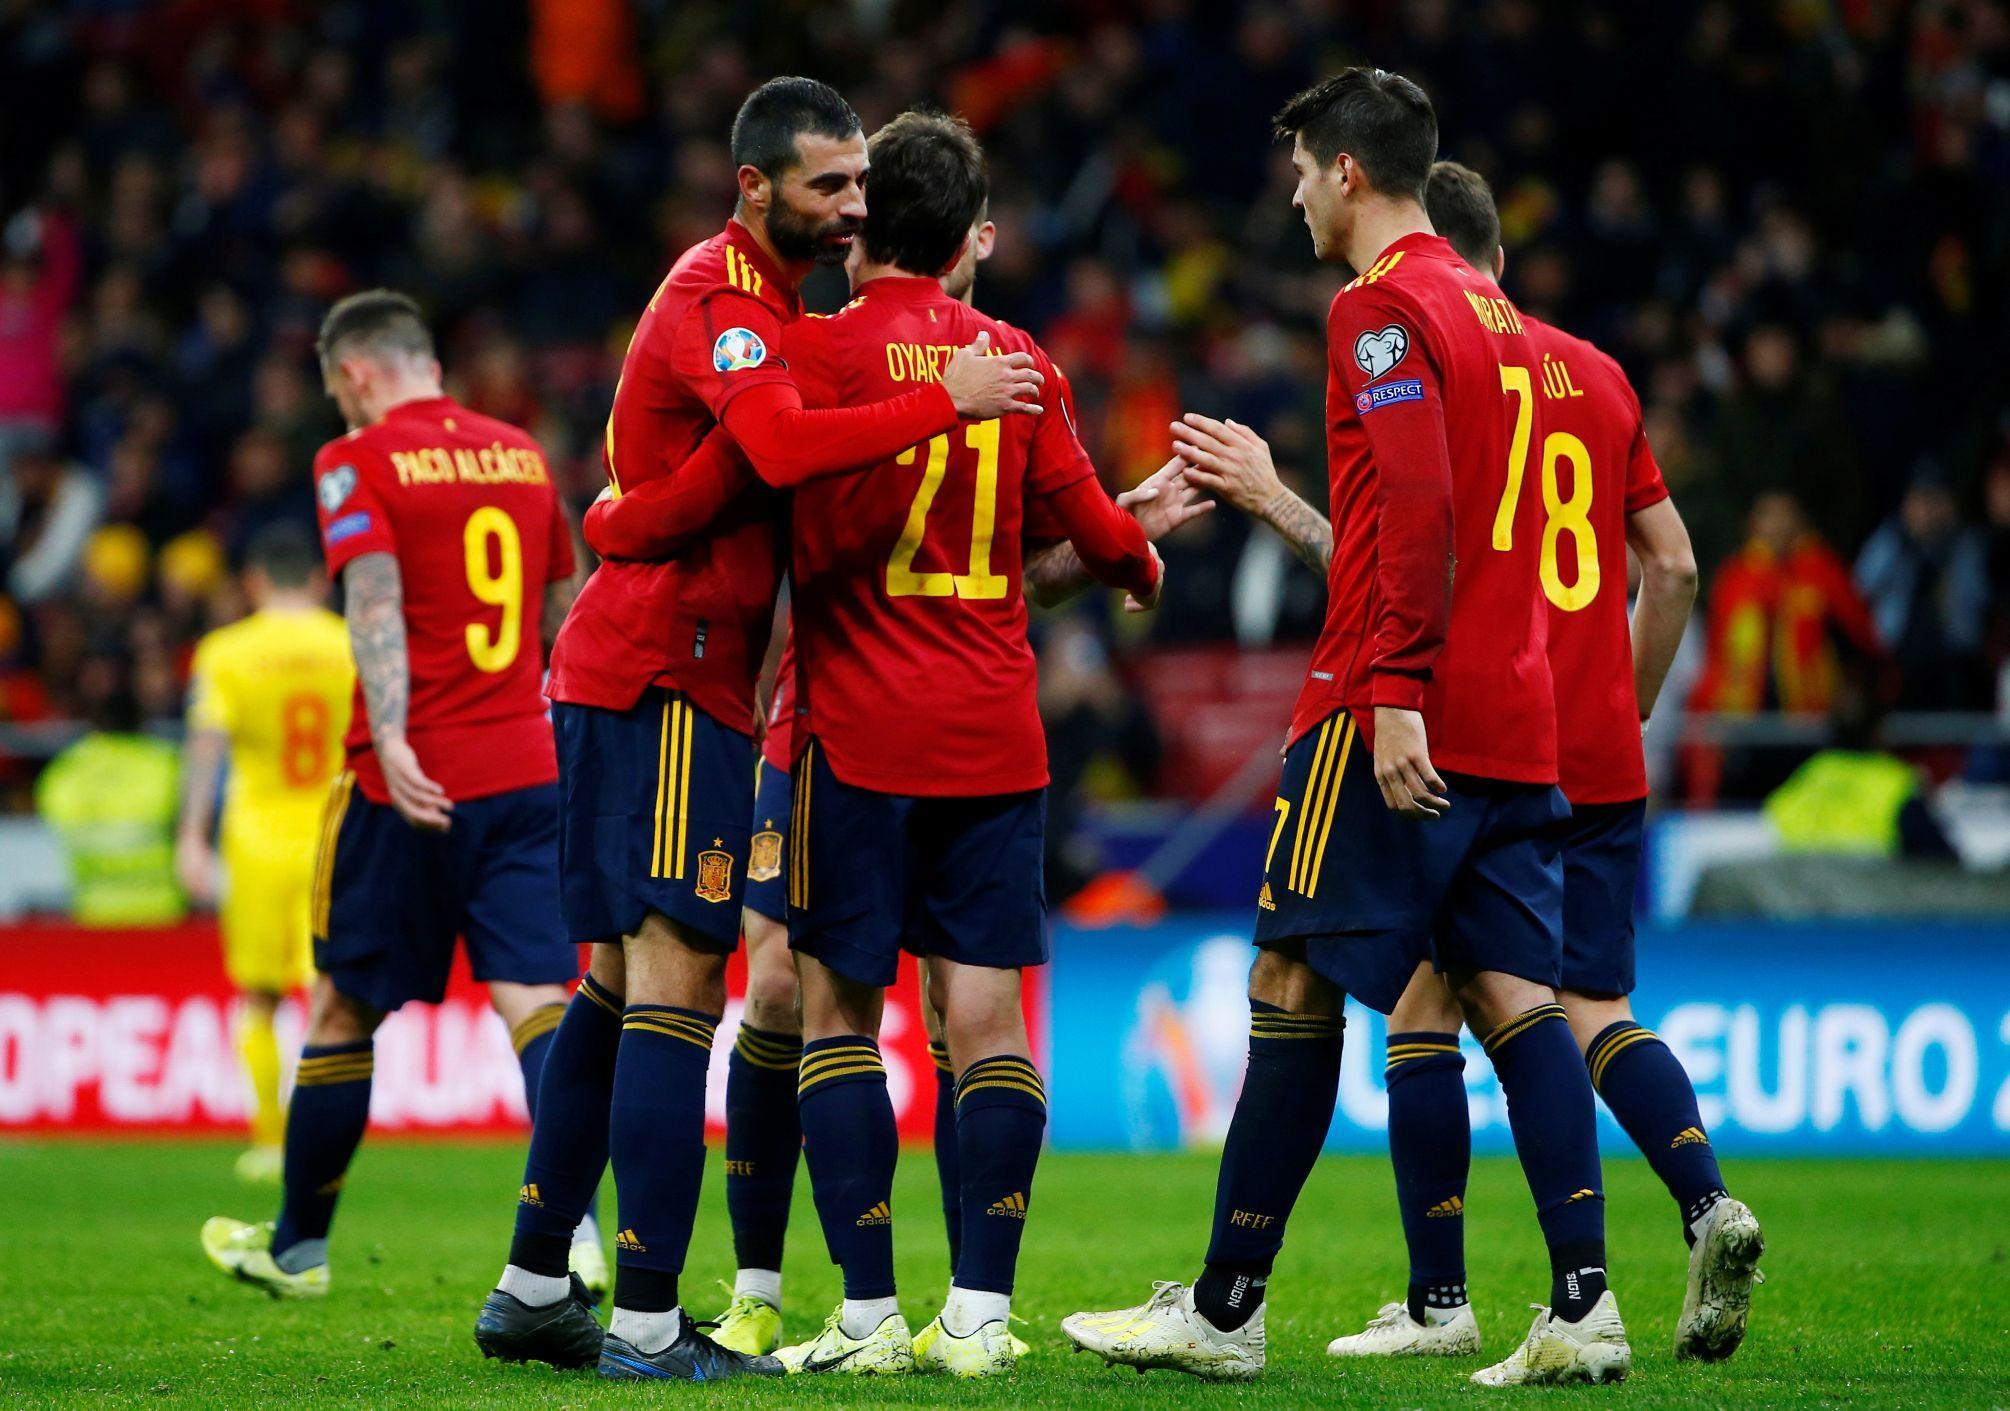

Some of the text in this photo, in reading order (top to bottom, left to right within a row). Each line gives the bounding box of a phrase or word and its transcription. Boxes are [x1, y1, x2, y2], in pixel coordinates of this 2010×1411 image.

[886, 342, 1003, 384] OYARZ
[1372, 384, 1422, 403] RESPECT
[885, 417, 1009, 600] 21
[1492, 362, 1534, 552] 7
[1539, 431, 1601, 612] 8
[463, 505, 523, 673] 9
[280, 689, 330, 791] 8
[1265, 796, 1291, 874] 7
[1658, 1002, 1979, 1132] EURO
[1230, 1209, 1275, 1230] RFEF
